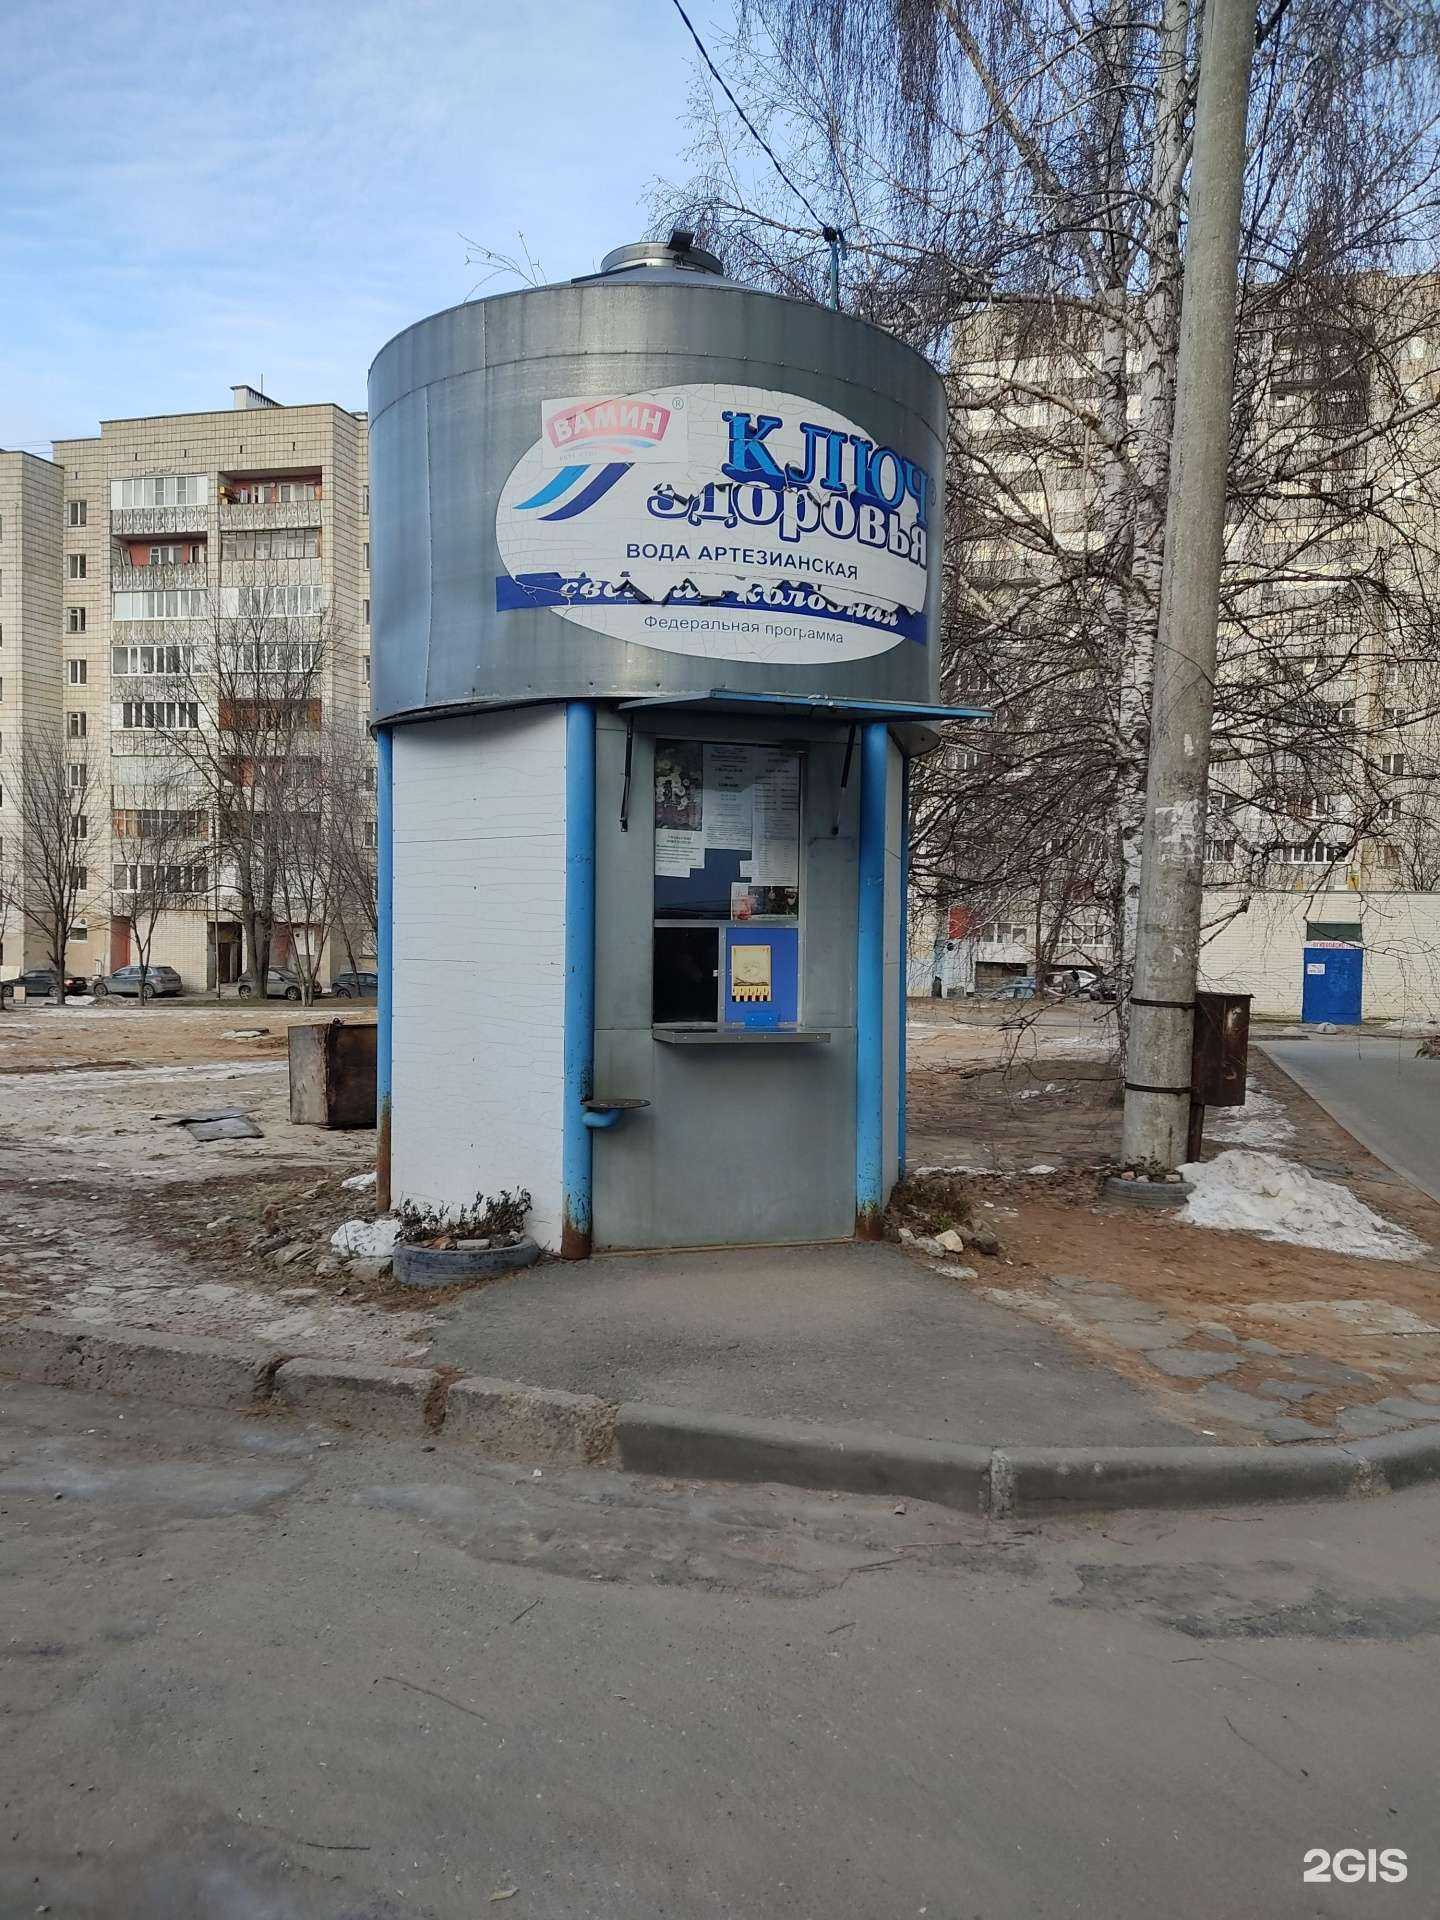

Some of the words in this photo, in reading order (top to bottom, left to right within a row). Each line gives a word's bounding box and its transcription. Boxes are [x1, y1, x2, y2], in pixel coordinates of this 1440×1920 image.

[626, 543, 690, 561] ВОДА
[698, 546, 858, 580] АРТЕЗИАНСКАЯ
[644, 615, 760, 634] Федеральная
